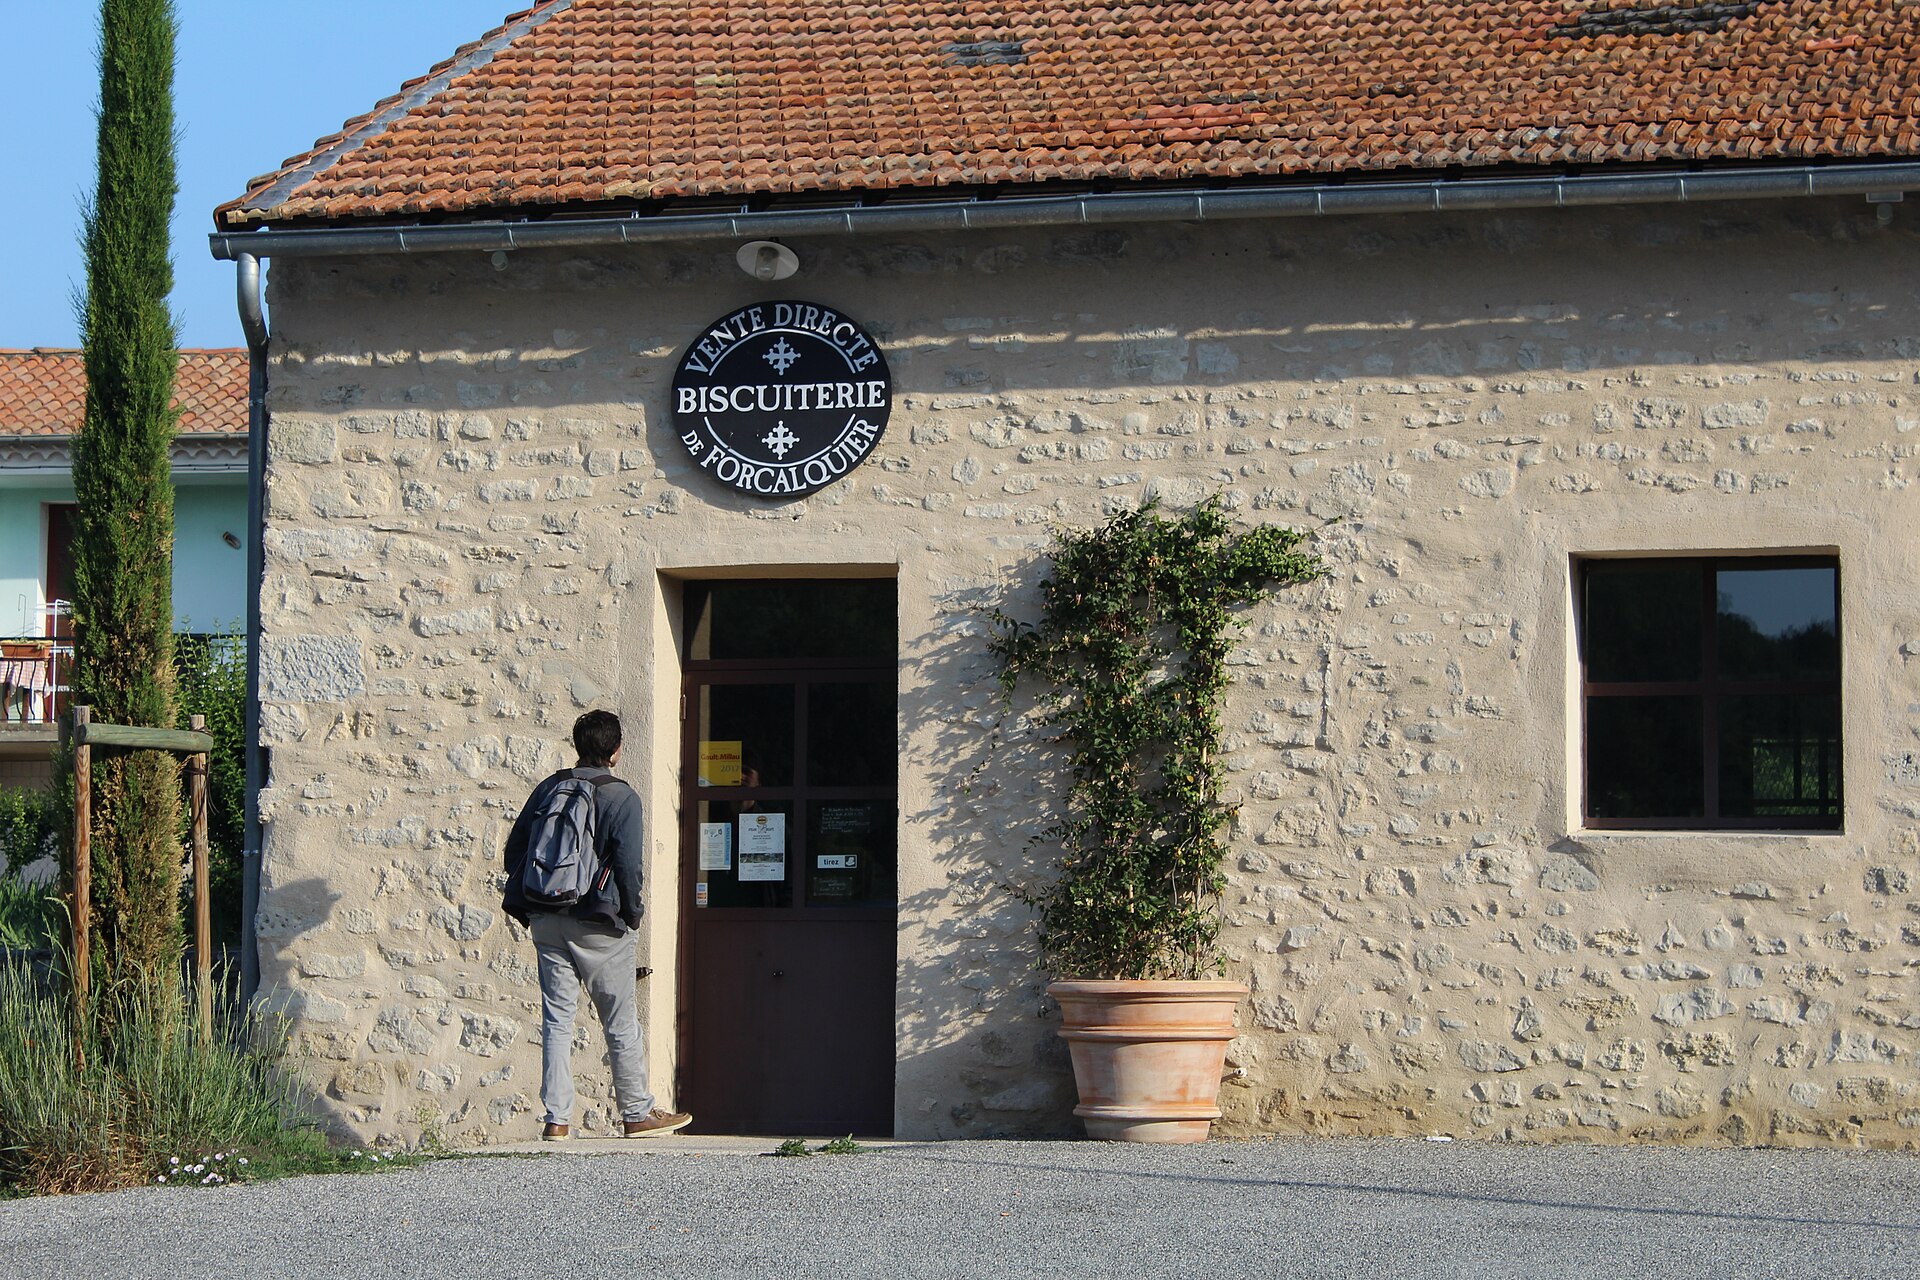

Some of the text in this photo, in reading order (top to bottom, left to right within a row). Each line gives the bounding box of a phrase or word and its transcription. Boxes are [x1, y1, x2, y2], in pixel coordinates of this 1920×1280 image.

[685, 303, 879, 373] VENTE DIRECTE
[677, 381, 886, 414] BISCUITERIE
[682, 418, 879, 493] DE FORCALQUIER
[720, 764, 740, 772] 2017
